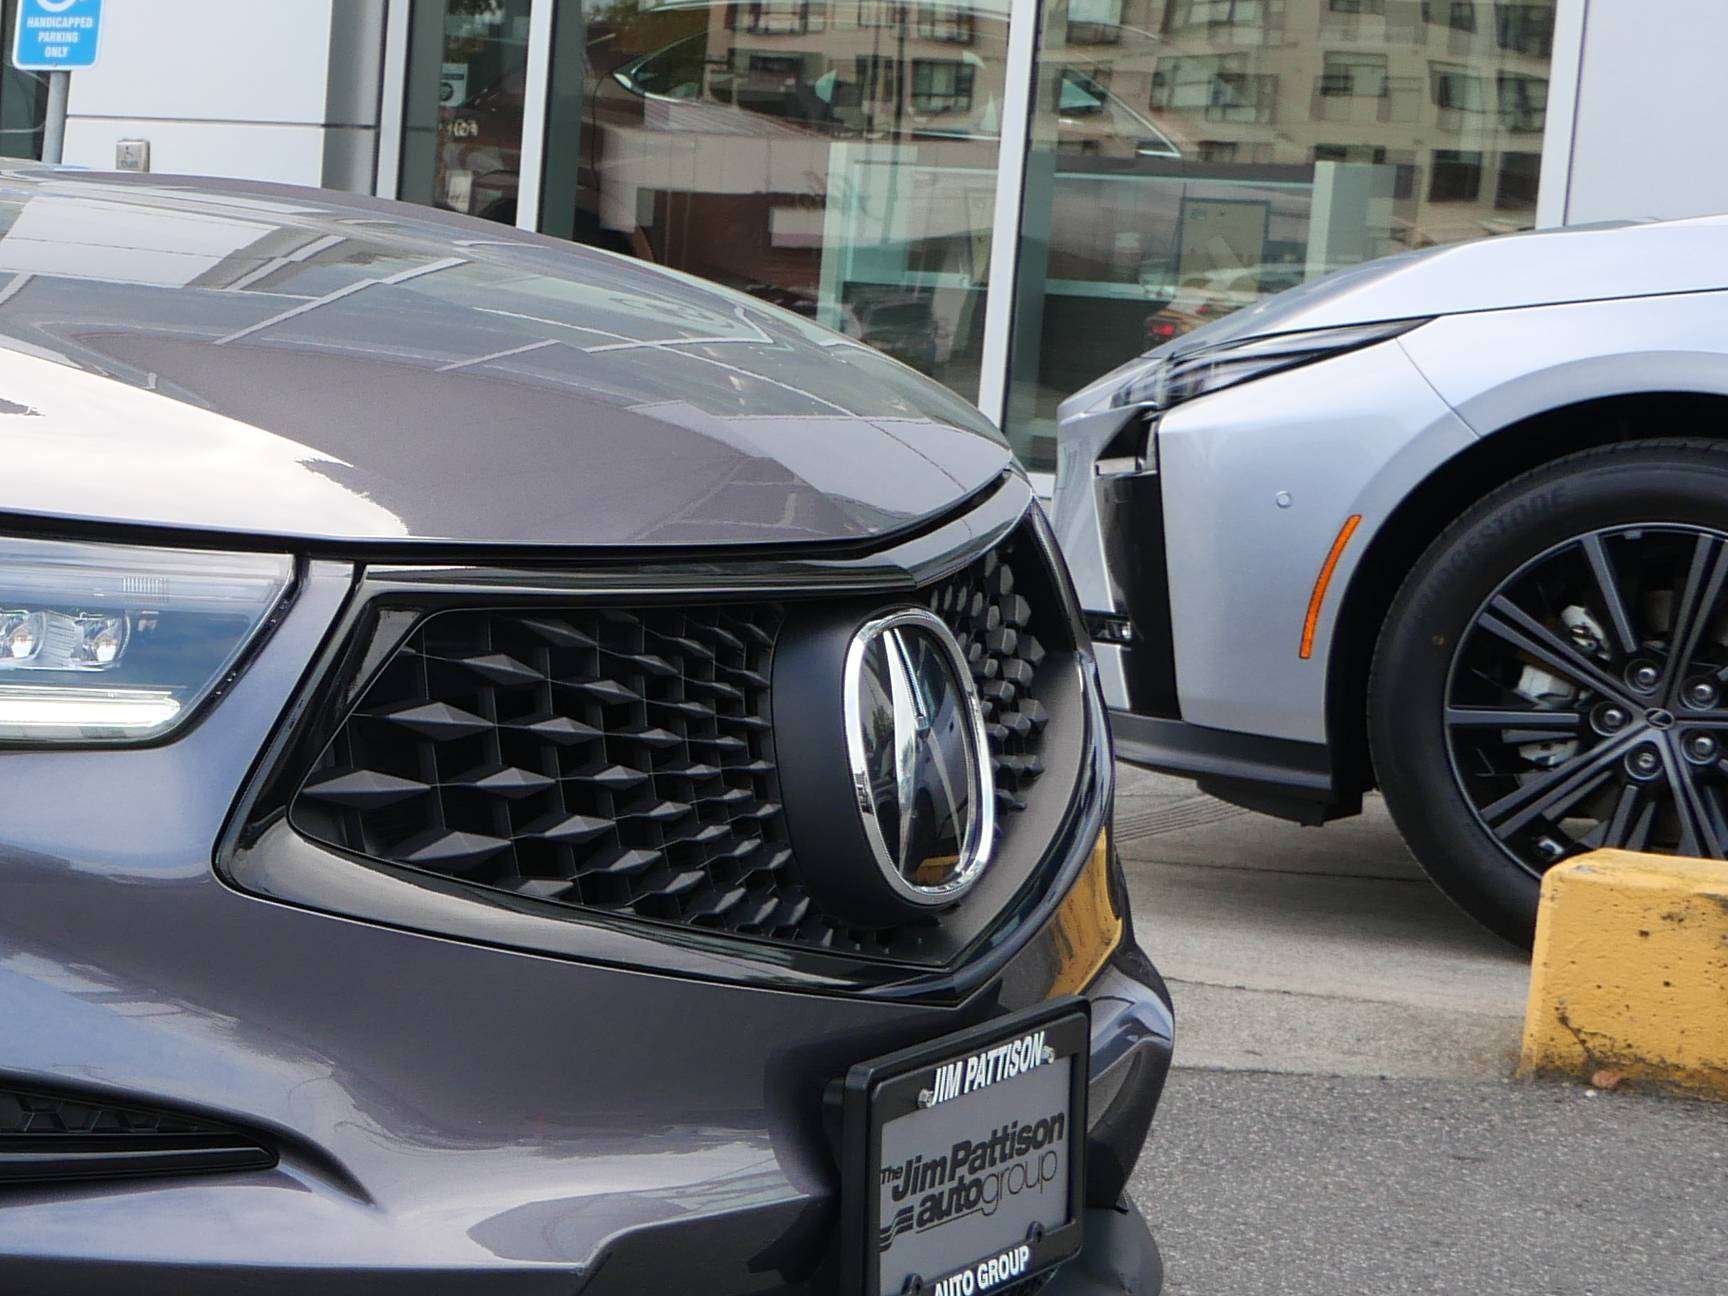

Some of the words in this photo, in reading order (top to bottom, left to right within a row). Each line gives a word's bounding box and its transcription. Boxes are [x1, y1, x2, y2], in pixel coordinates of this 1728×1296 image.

[26, 16, 94, 29] HANDICAPPED
[37, 31, 79, 43] PARKING
[45, 46, 71, 58] ONLY
[931, 1060, 964, 1106] JIM
[964, 1030, 1046, 1094] PATTISON
[891, 1154, 948, 1202] Jim
[948, 1112, 1065, 1183] Pattison
[977, 1244, 1030, 1291] GROUP
